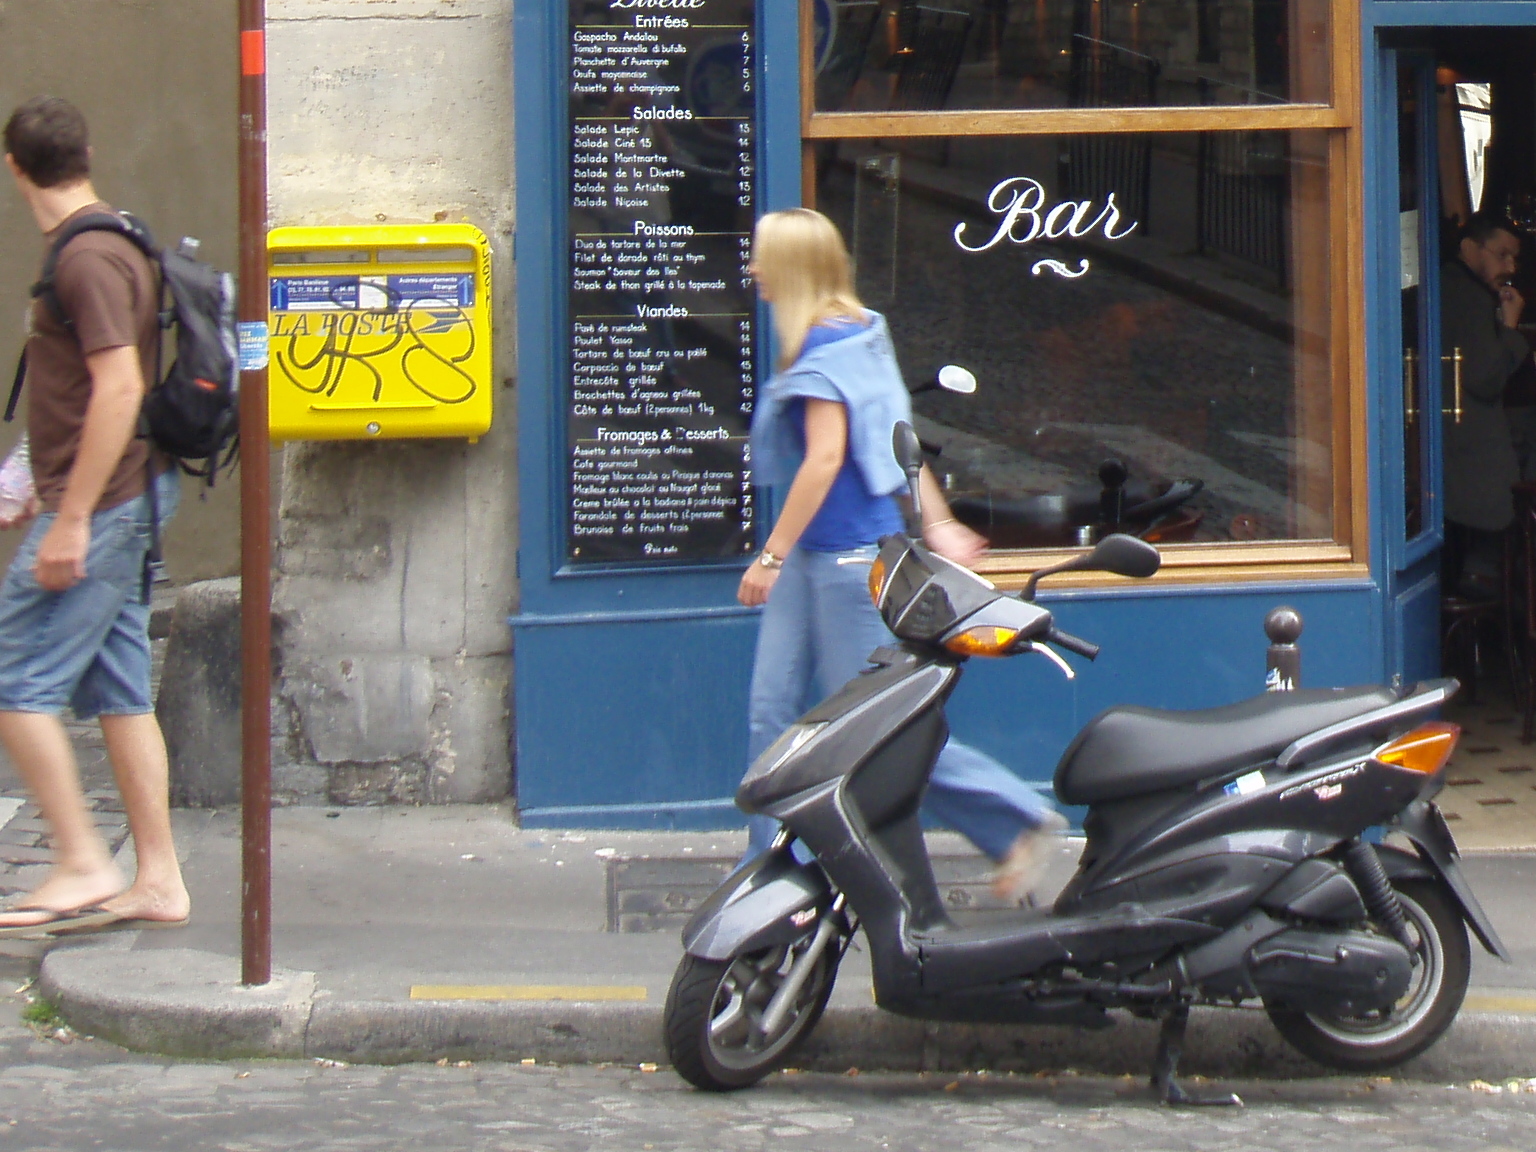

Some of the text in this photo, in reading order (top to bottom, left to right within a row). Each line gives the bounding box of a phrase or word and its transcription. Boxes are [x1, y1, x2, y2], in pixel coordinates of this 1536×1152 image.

[635, 15, 689, 28] Entrées
[742, 32, 748, 41] 6
[743, 45, 749, 53] 7
[743, 56, 750, 65] 7
[742, 69, 750, 78] 5
[614, 83, 624, 92] de
[743, 82, 750, 92] 6
[633, 105, 692, 120] Salades
[574, 124, 607, 134] Salade
[614, 125, 639, 136] Lepic
[574, 138, 608, 148] Salade
[574, 153, 750, 163] Salade Montmartre 12
[574, 167, 750, 178] Salade de la Divette 12
[574, 183, 605, 192] Salade
[574, 197, 607, 207] Salade
[738, 196, 750, 206] 12
[954, 177, 1138, 251] Bar
[634, 220, 694, 236] Poissons
[646, 240, 656, 248] de
[659, 239, 668, 248] la
[601, 252, 613, 262] de
[574, 280, 601, 290] Steak
[605, 280, 617, 290] de
[621, 280, 640, 290] thon
[637, 303, 689, 317] Viandes
[271, 313, 311, 336] LA
[598, 322, 608, 332] de
[613, 348, 624, 358] de
[625, 362, 636, 372] de
[602, 404, 613, 414] de
[598, 427, 672, 446] Fromages &
